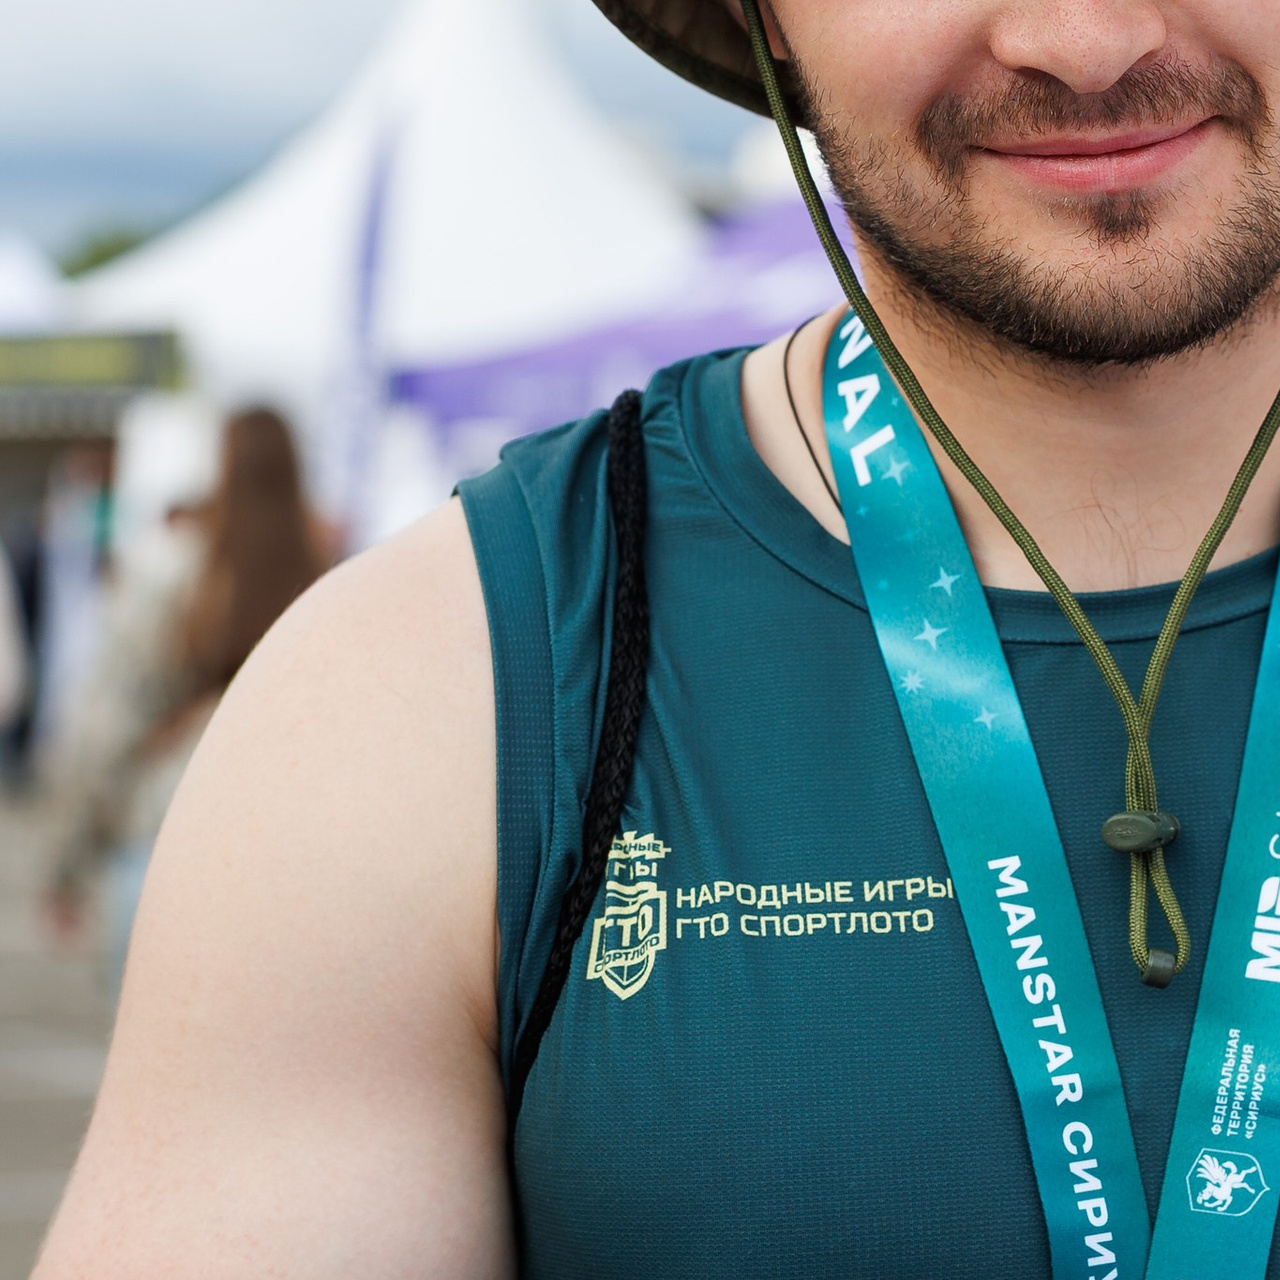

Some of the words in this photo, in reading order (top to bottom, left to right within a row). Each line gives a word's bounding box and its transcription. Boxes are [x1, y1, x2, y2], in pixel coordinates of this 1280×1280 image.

[838, 316, 896, 487] NAL
[677, 882, 853, 908] НАРОДНЫЕ
[864, 876, 953, 901] ИГРЫ
[677, 913, 729, 938] ГТО
[741, 909, 933, 936] СПОРТЛОТО
[988, 856, 1082, 1105] MANSTAR
[1211, 1029, 1240, 1135] ФЕДЕРАЛЬНАЯ
[1227, 1045, 1254, 1136] ТЕРРИТОРИЯ
[1245, 1064, 1266, 1139] «СИРИУС»
